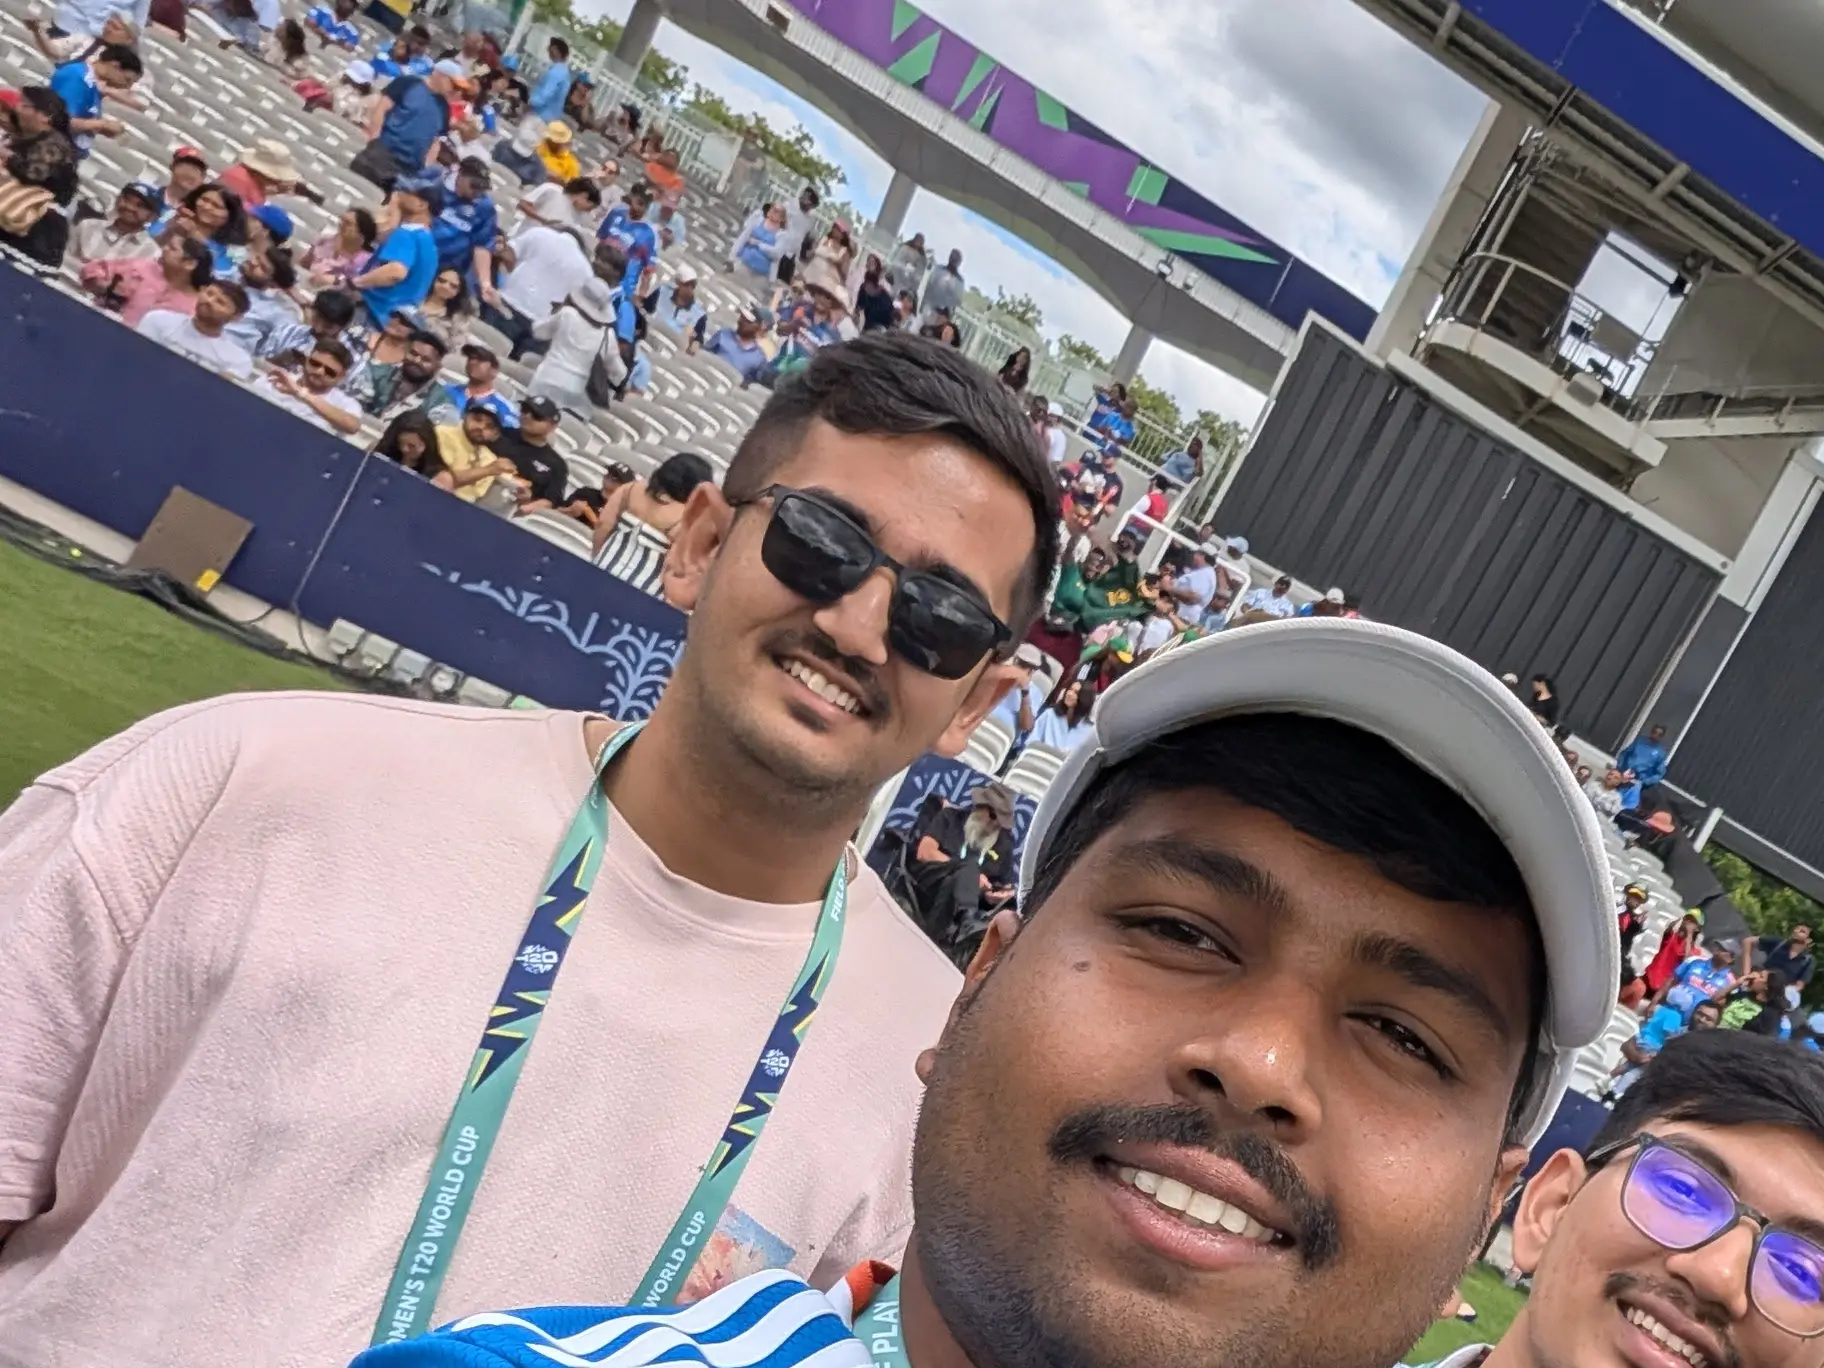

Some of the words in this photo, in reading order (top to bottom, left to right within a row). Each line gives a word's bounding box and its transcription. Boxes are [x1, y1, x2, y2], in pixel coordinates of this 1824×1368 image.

[452, 1124, 480, 1166] CUP
[423, 1168, 465, 1239] WORLD
[409, 1241, 439, 1275] T20
[642, 1248, 687, 1307] WORLD
[681, 1210, 706, 1247] CUP
[872, 1300, 899, 1354] PLAY
